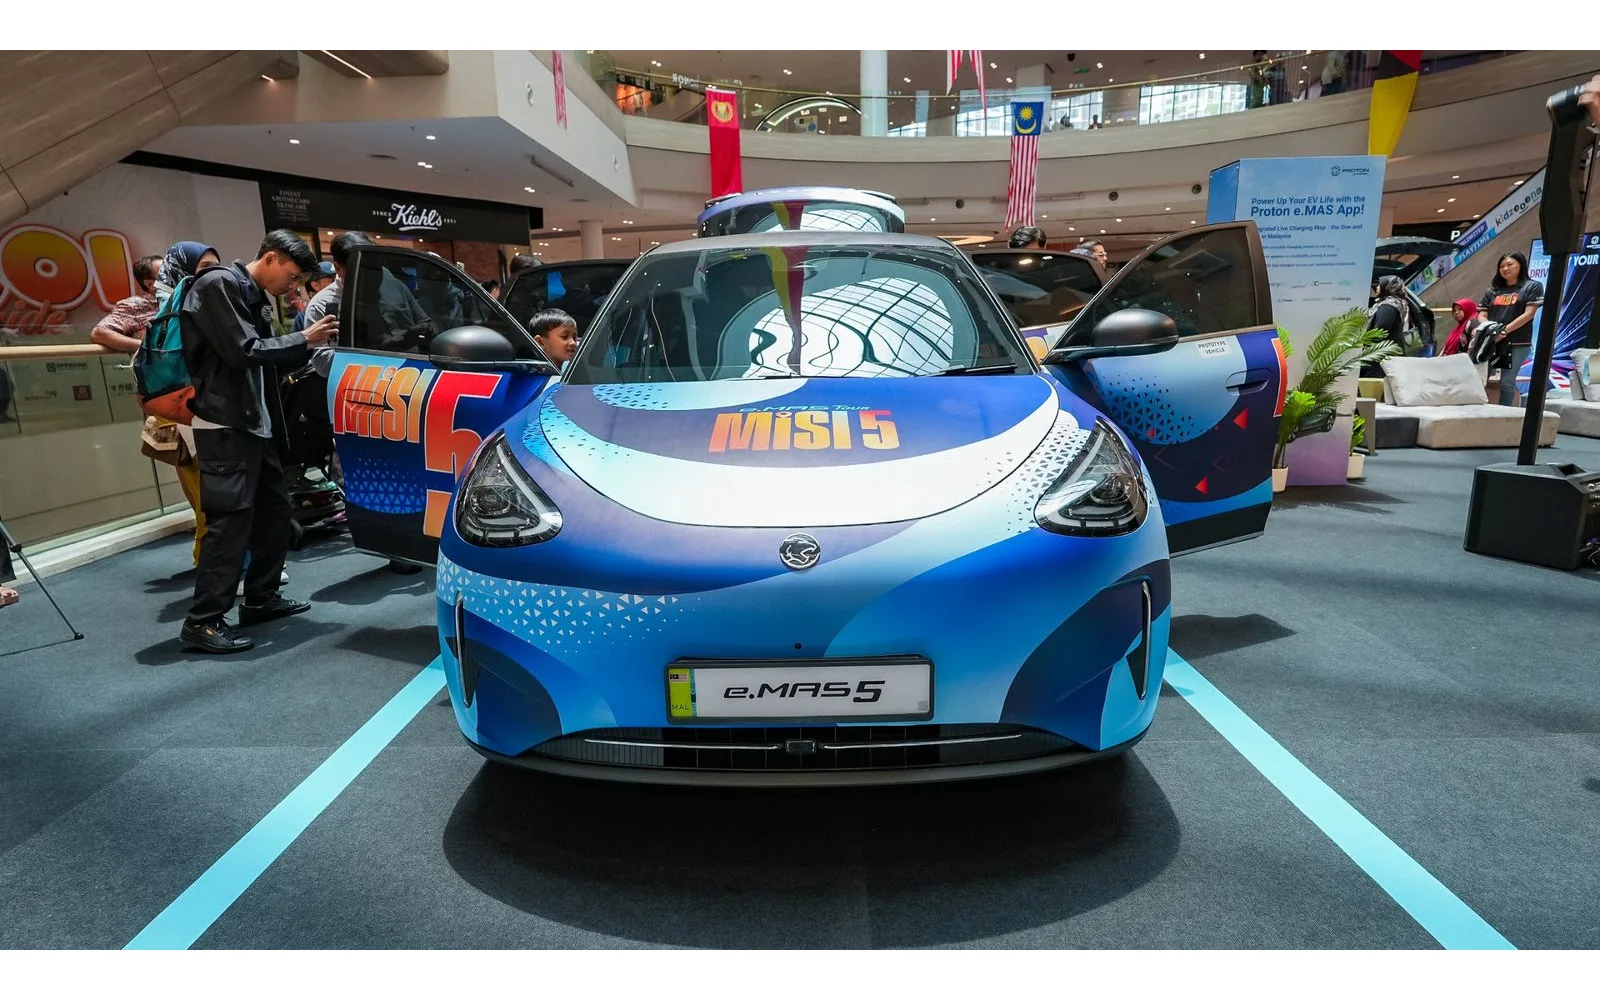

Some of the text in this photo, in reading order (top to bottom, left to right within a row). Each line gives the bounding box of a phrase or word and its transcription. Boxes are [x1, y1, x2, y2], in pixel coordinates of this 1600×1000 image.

[1251, 194, 1366, 206] Power Up Your EV Life with the
[388, 202, 443, 227] Kiehl's
[1250, 204, 1365, 218] Proton e.MAS App!
[1289, 225, 1313, 233] Charging
[1314, 224, 1326, 232] Map
[1573, 254, 1599, 266] YOUR
[1530, 268, 1549, 278] DRIV
[1197, 341, 1226, 349] PROTOTYPE
[858, 410, 900, 450] 5
[671, 703, 689, 711] MAL
